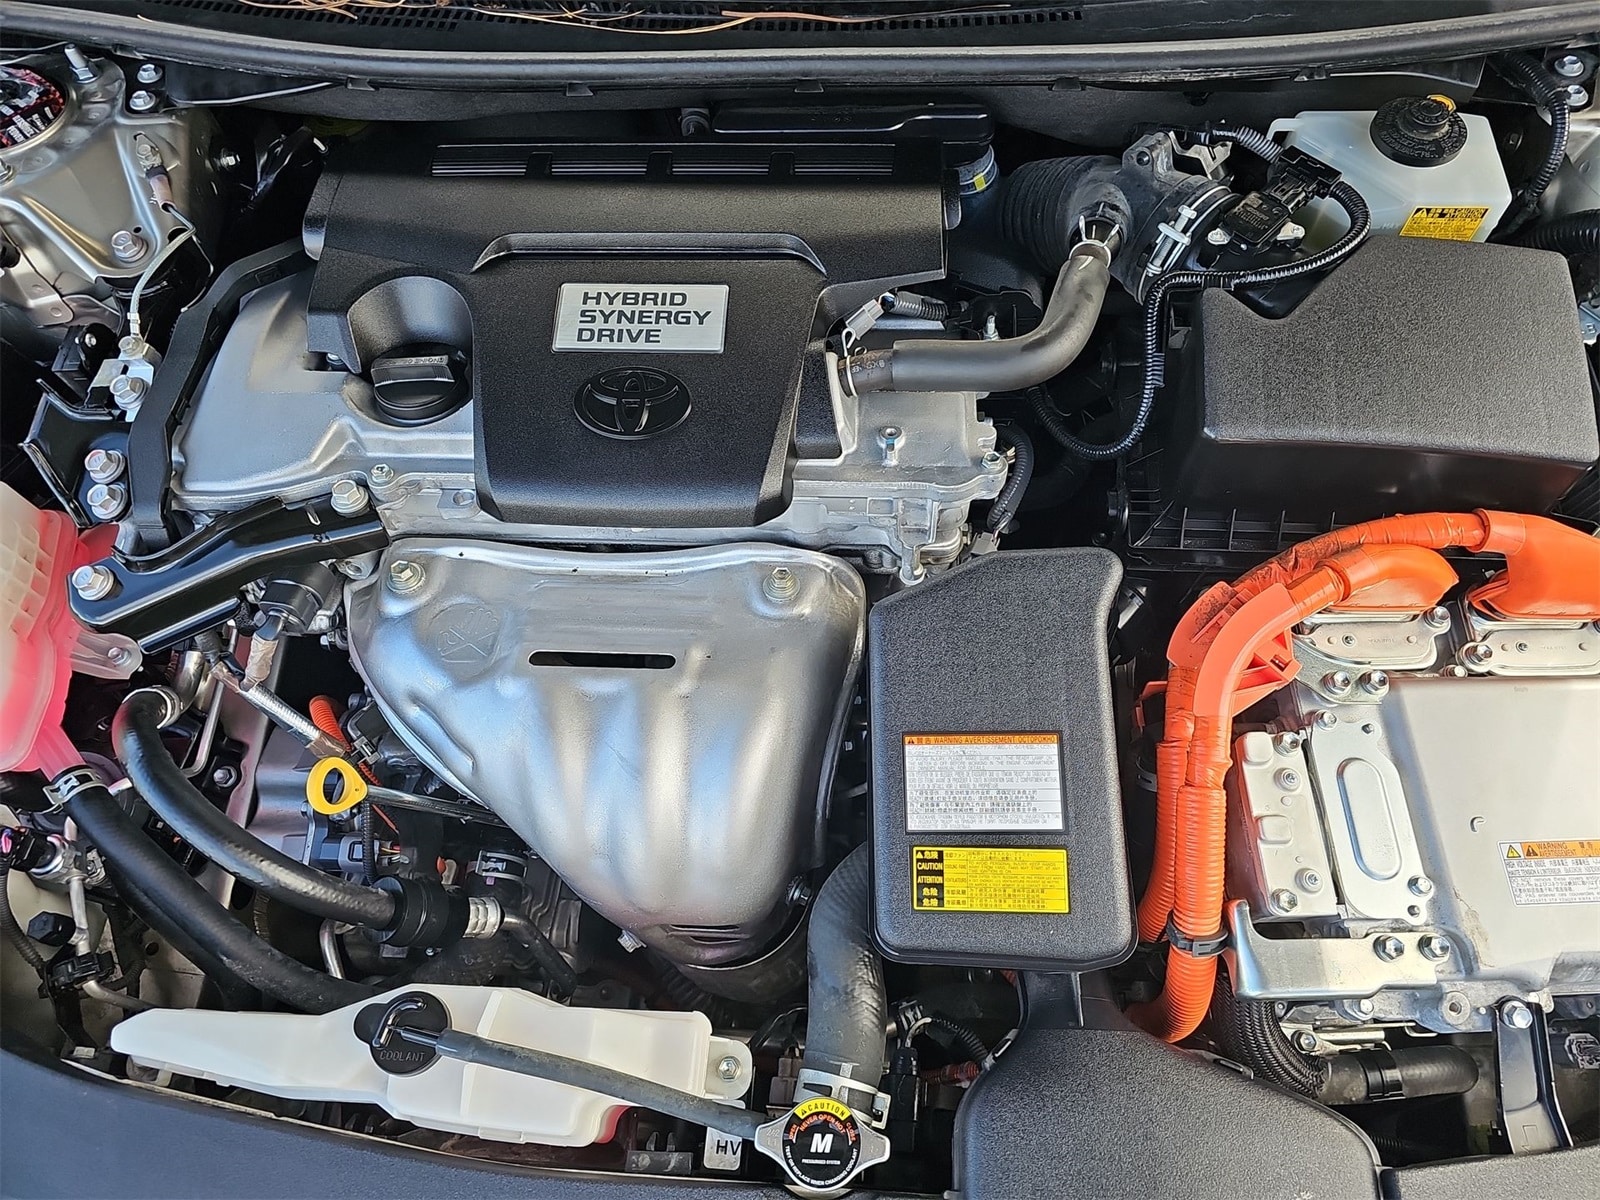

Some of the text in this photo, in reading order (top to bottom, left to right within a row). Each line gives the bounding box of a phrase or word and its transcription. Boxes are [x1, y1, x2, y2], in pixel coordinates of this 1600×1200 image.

[582, 292, 688, 307] HYBRID
[579, 309, 712, 325] SYNERGY
[577, 328, 662, 344] DRIVE
[934, 736, 963, 744] WARNING
[965, 735, 1015, 744] AVERTISSEMENT
[1537, 842, 1568, 850] WARNING
[917, 862, 943, 870] CAUTION
[917, 875, 943, 884] ATTENTION
[380, 1050, 425, 1062] COOLANT
[808, 1102, 846, 1117] CAUTION
[800, 1113, 846, 1134] NEVER OPEN HOT
[846, 1121, 857, 1141] CLOSE
[716, 1139, 742, 1156] HV
[810, 1133, 834, 1154] M
[788, 1158, 795, 1166] OR
[792, 1165, 811, 1183] REPLACE
[824, 1170, 848, 1185] CHANGING
[845, 1148, 858, 1172] COOLANT
